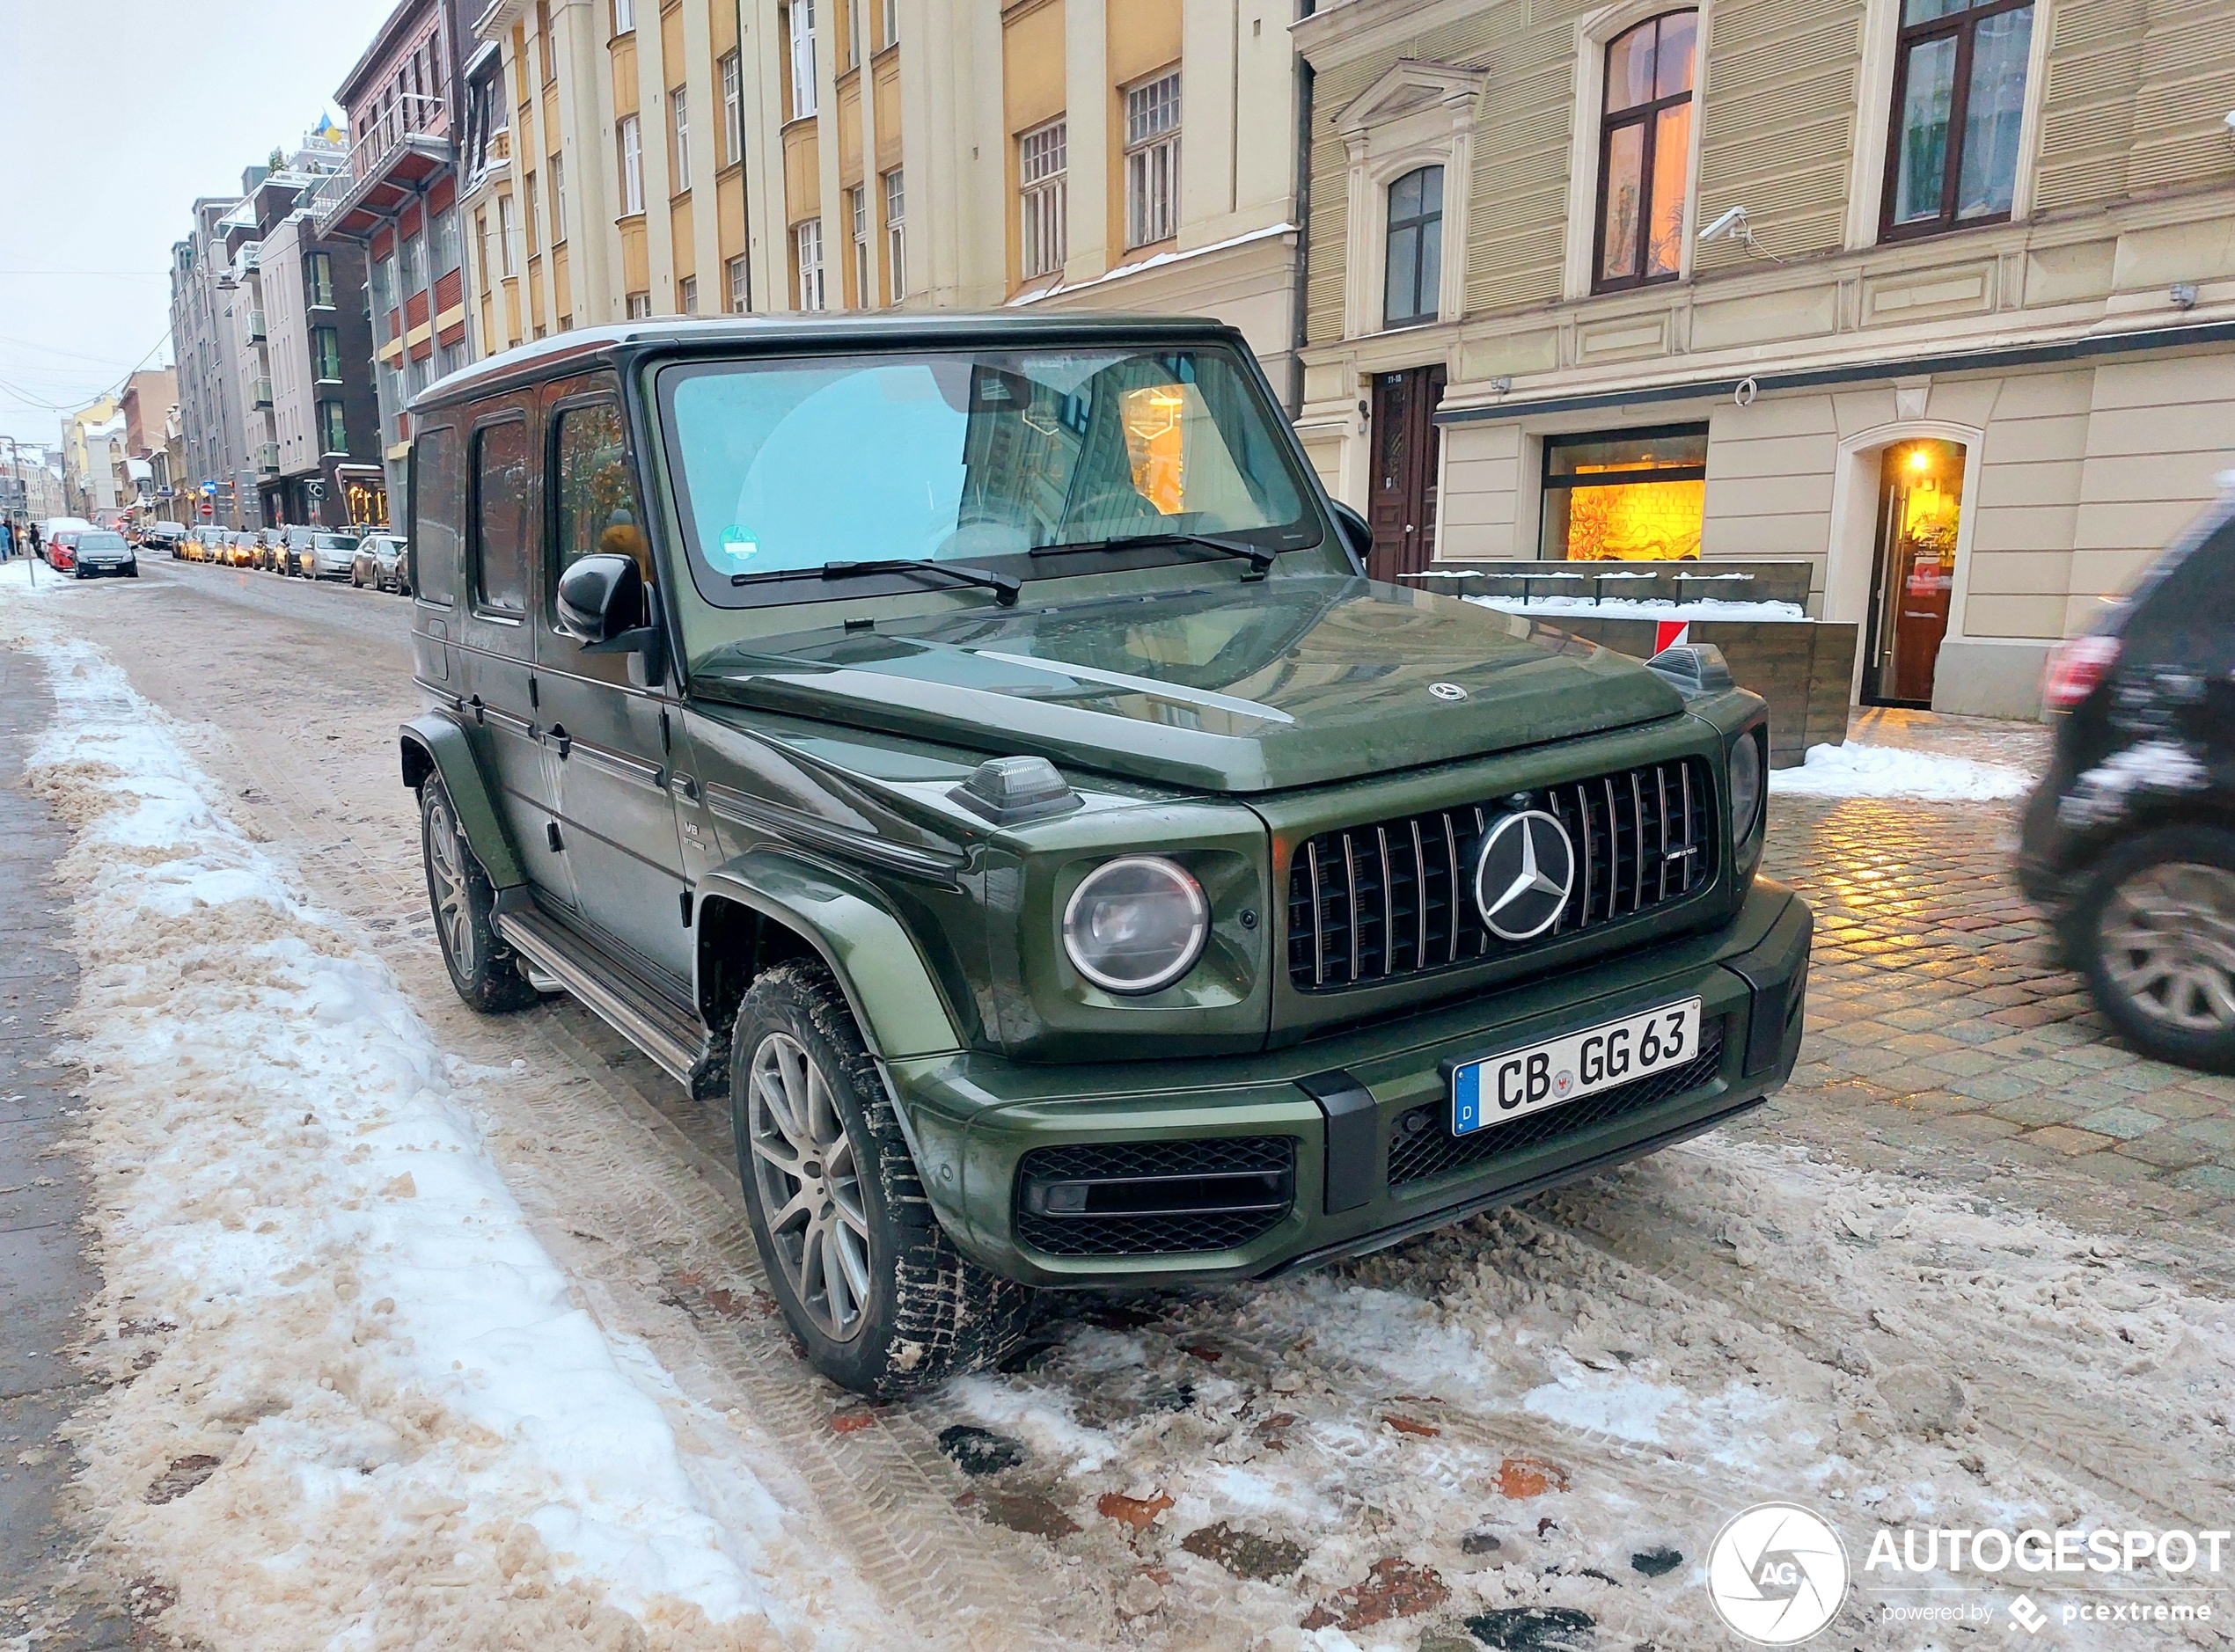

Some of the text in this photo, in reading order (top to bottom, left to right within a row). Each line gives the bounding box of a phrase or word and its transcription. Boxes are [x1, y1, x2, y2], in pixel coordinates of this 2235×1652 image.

[685, 822, 699, 836] V8
[1498, 1011, 1686, 1110] CB GG 63
[1462, 1105, 1472, 1121] D
